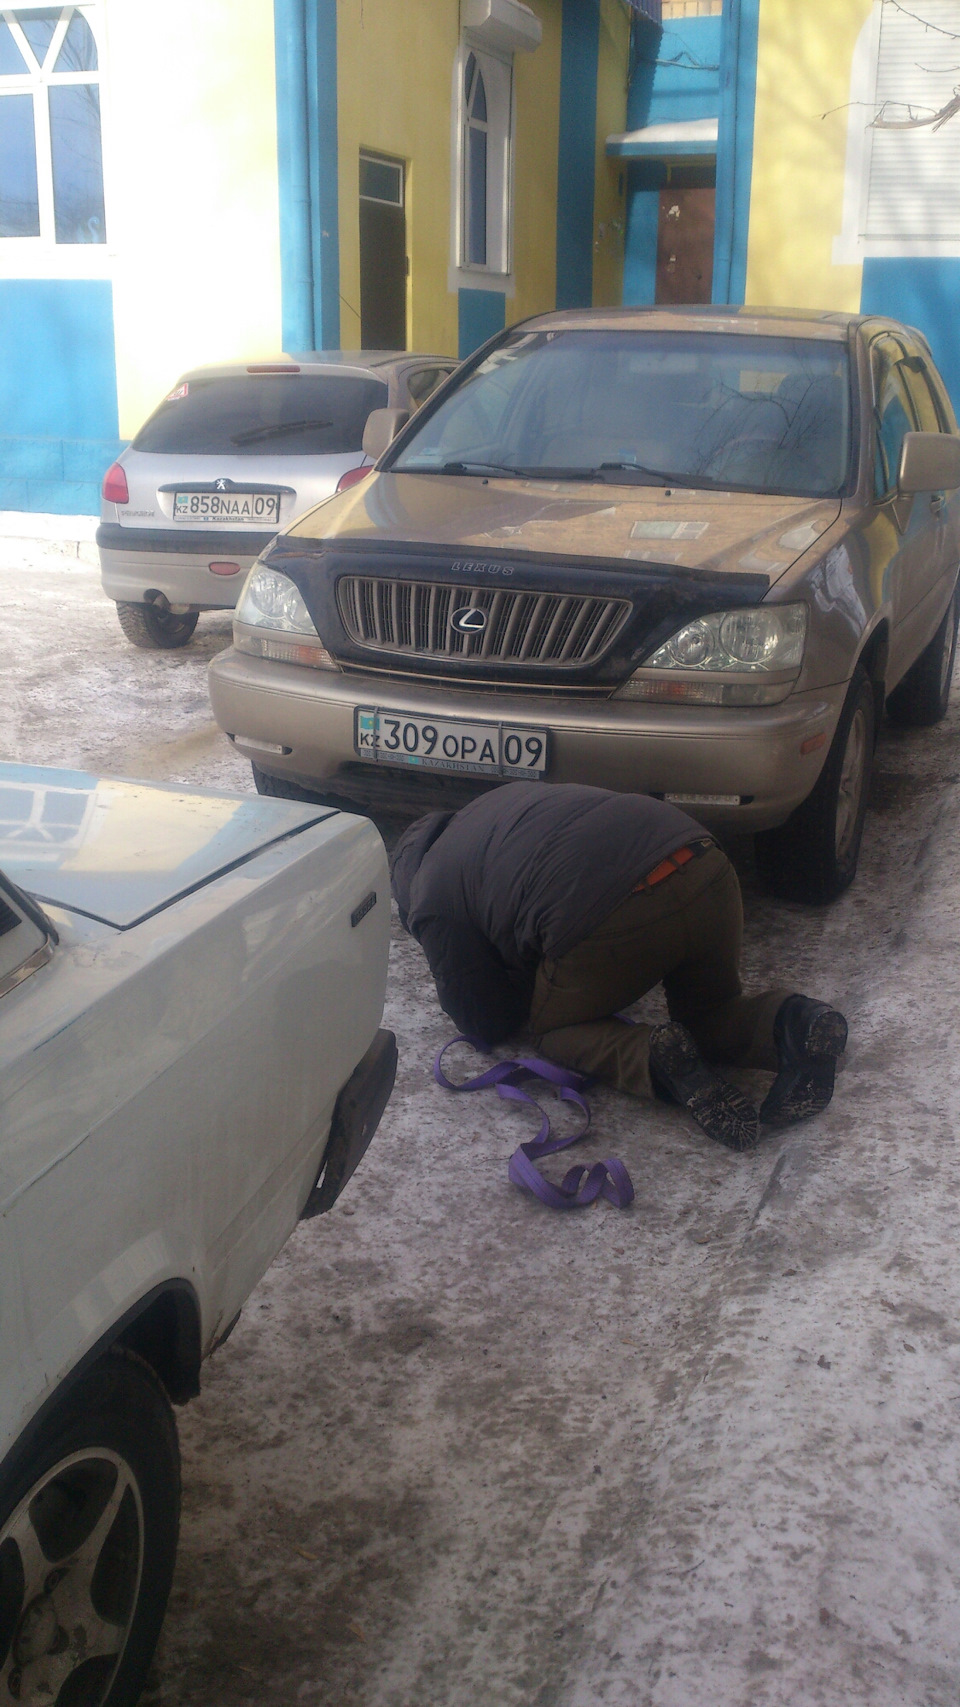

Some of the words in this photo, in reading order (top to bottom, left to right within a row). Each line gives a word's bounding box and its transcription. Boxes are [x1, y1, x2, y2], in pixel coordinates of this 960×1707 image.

[190, 496, 250, 515] 858NAA
[254, 497, 276, 516] 09
[451, 561, 515, 576] LEXUS
[504, 734, 543, 767] 09
